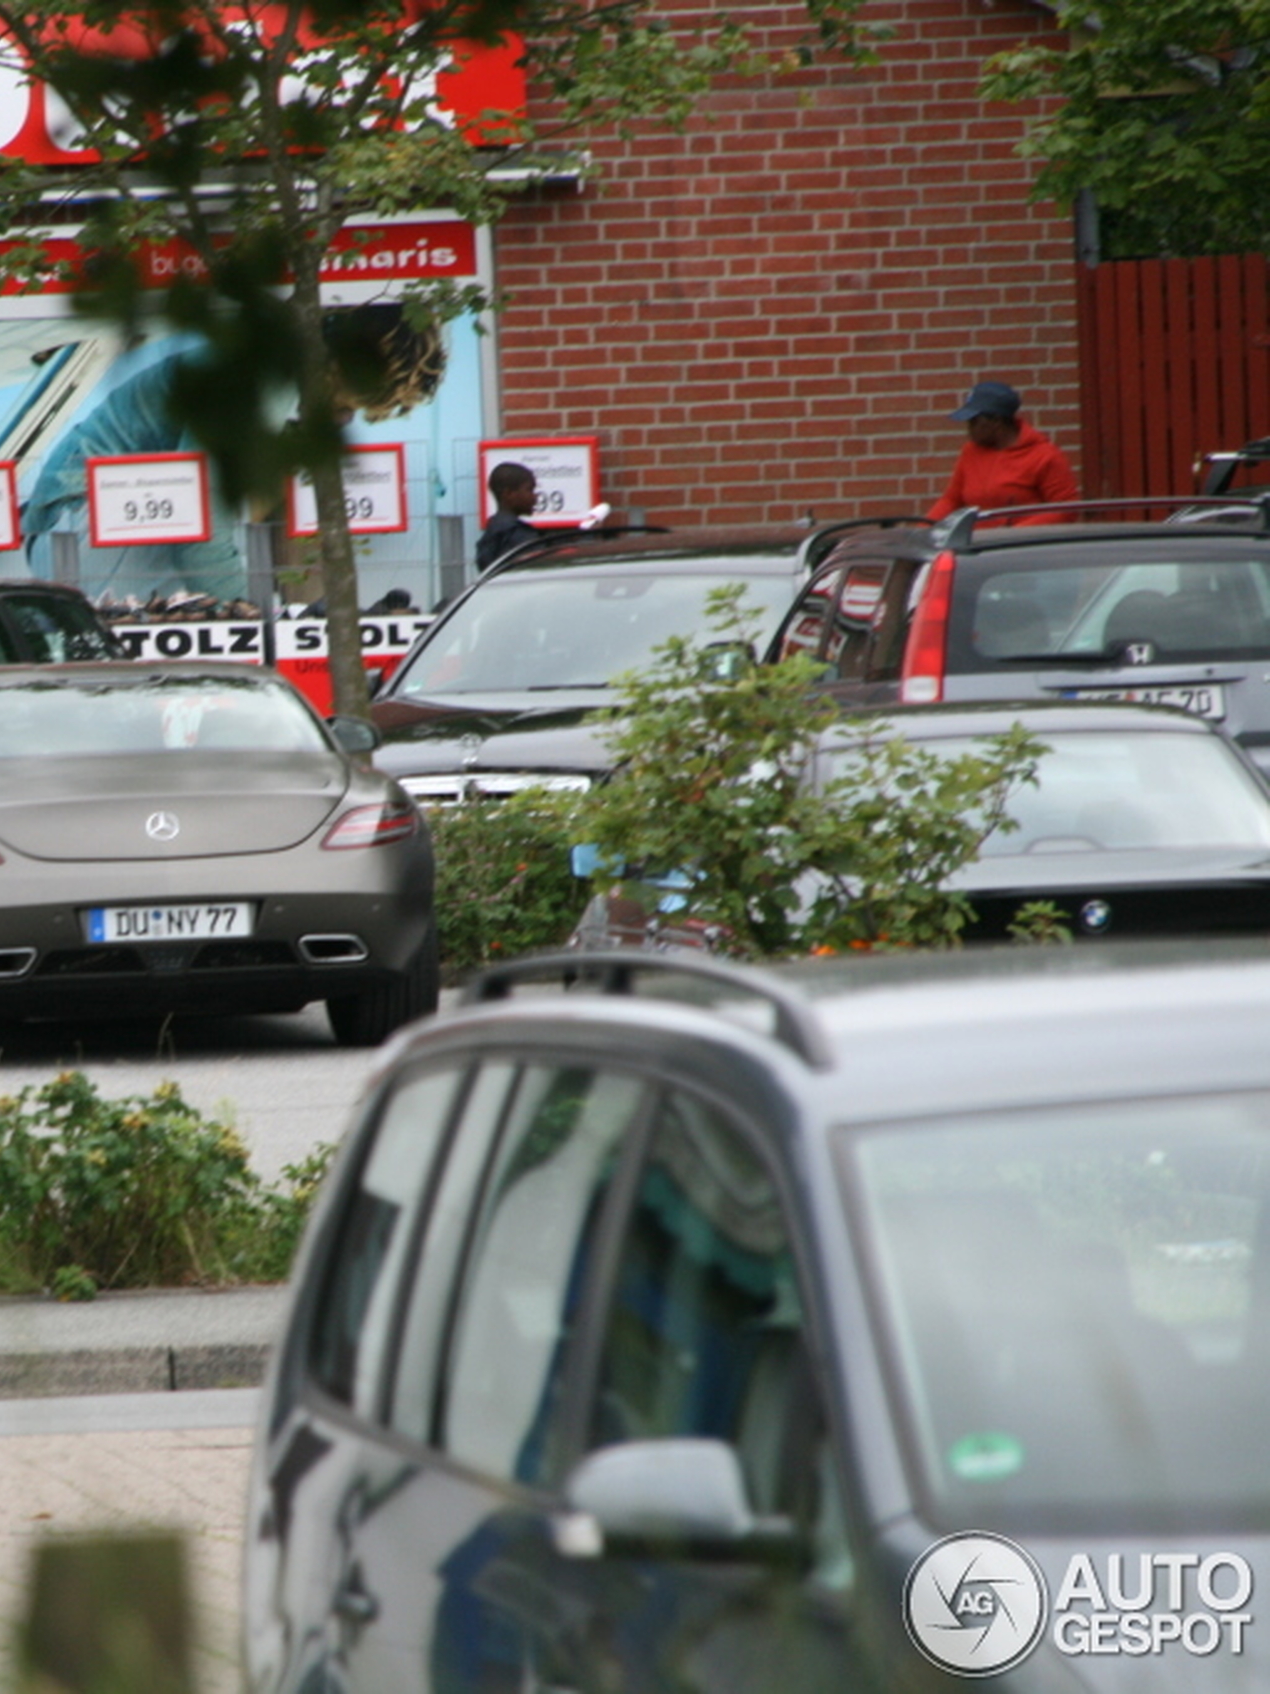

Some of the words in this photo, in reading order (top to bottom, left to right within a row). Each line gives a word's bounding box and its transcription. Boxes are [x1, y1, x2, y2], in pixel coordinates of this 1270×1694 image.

[124, 500, 173, 524] 9,99
[119, 626, 259, 658] TOLZ
[117, 910, 149, 936] DU
[167, 908, 200, 933] NY
[206, 906, 238, 933] 77
